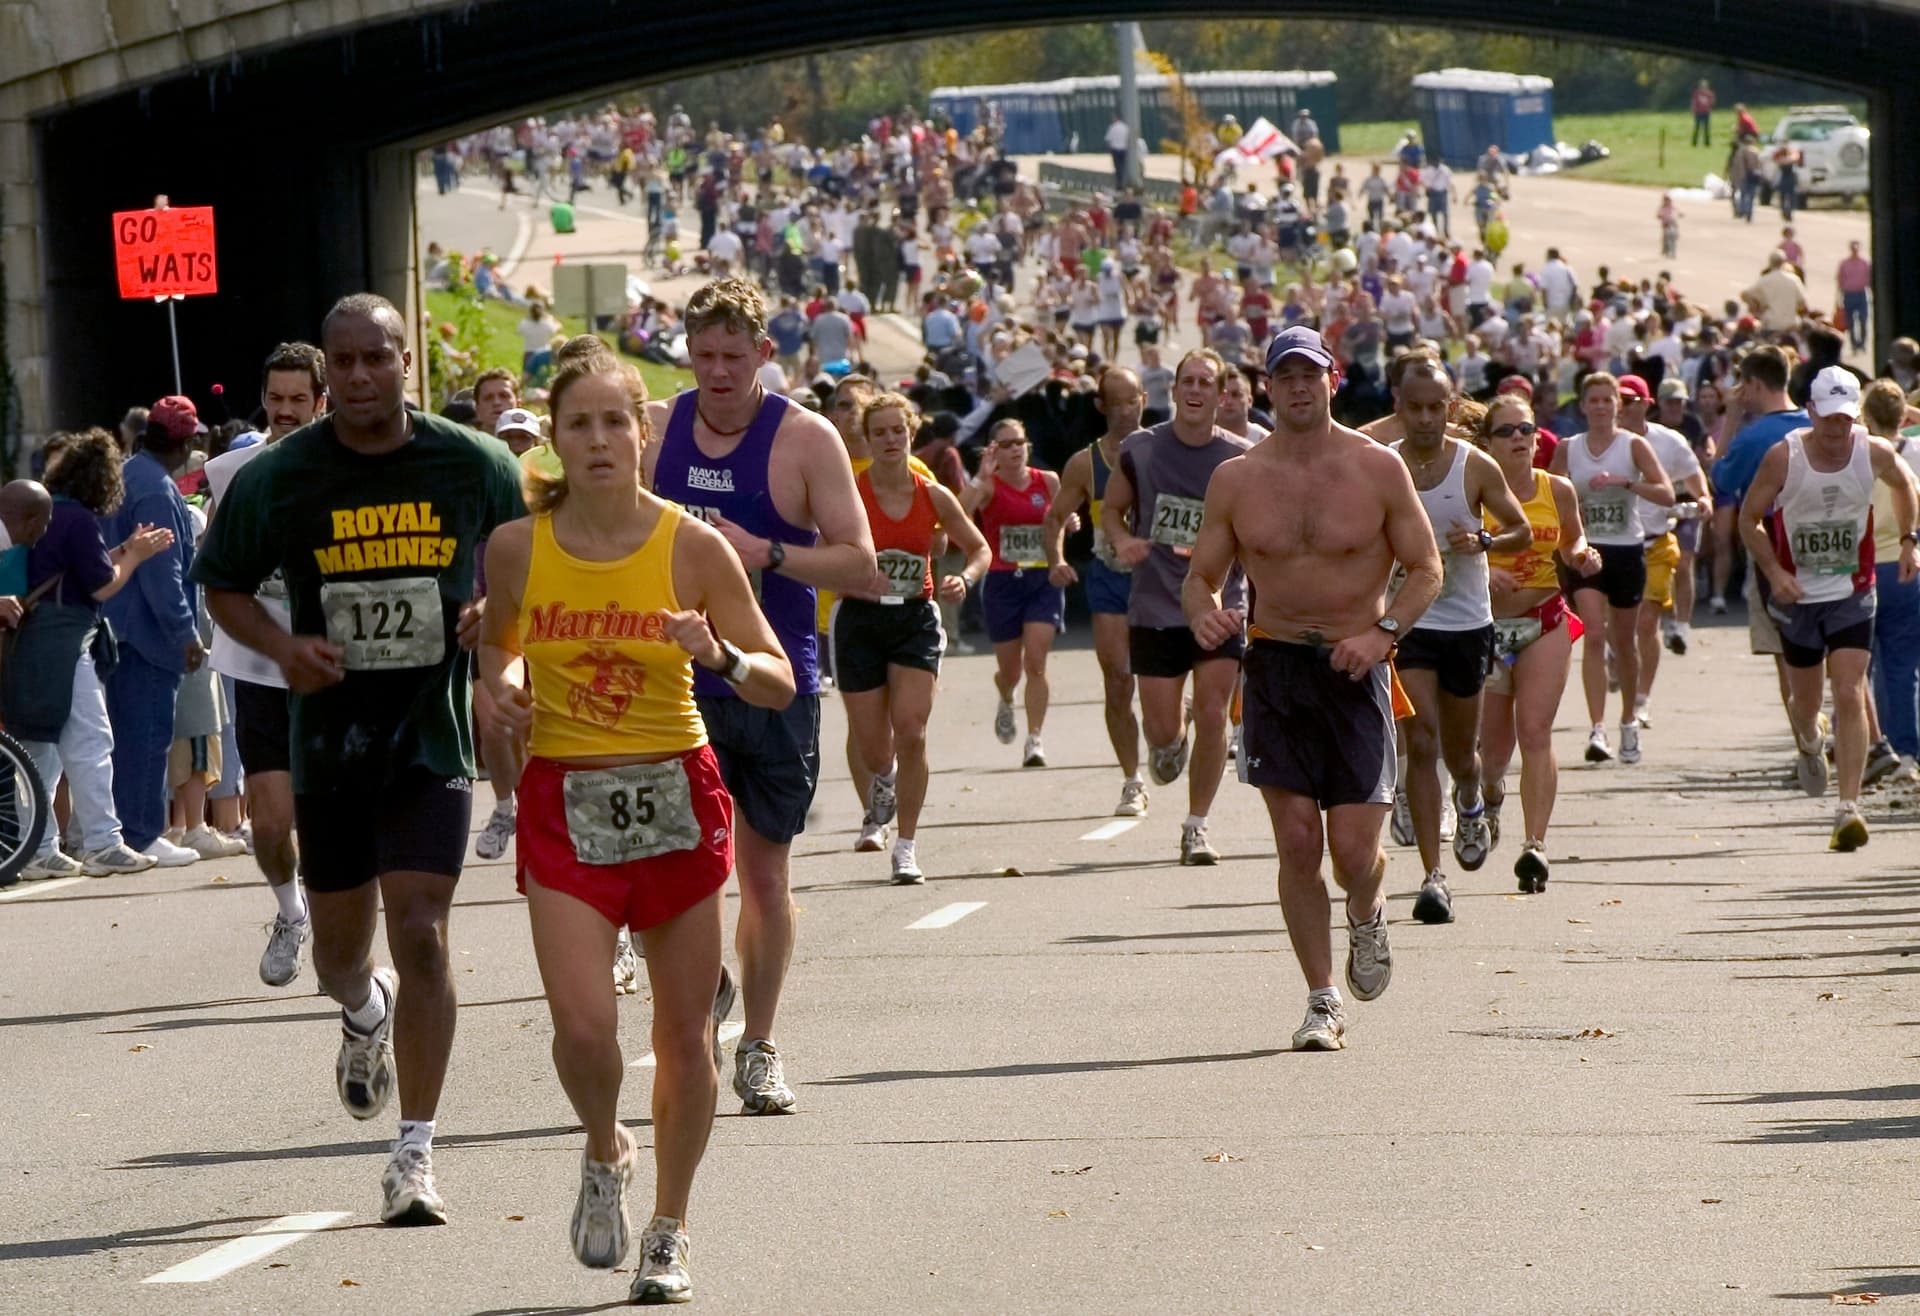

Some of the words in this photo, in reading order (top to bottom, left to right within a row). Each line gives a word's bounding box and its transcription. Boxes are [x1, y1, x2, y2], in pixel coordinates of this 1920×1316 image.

[120, 216, 157, 245] GO
[139, 253, 212, 283] WATS
[687, 475, 735, 490] FEDERAL
[688, 466, 721, 480] NAVY
[331, 502, 441, 541] ROYAL
[1158, 505, 1203, 534] 2143
[313, 536, 457, 575] MARINES
[1798, 529, 1852, 555] 16346
[351, 600, 414, 641] 122
[609, 786, 655, 831] 85
